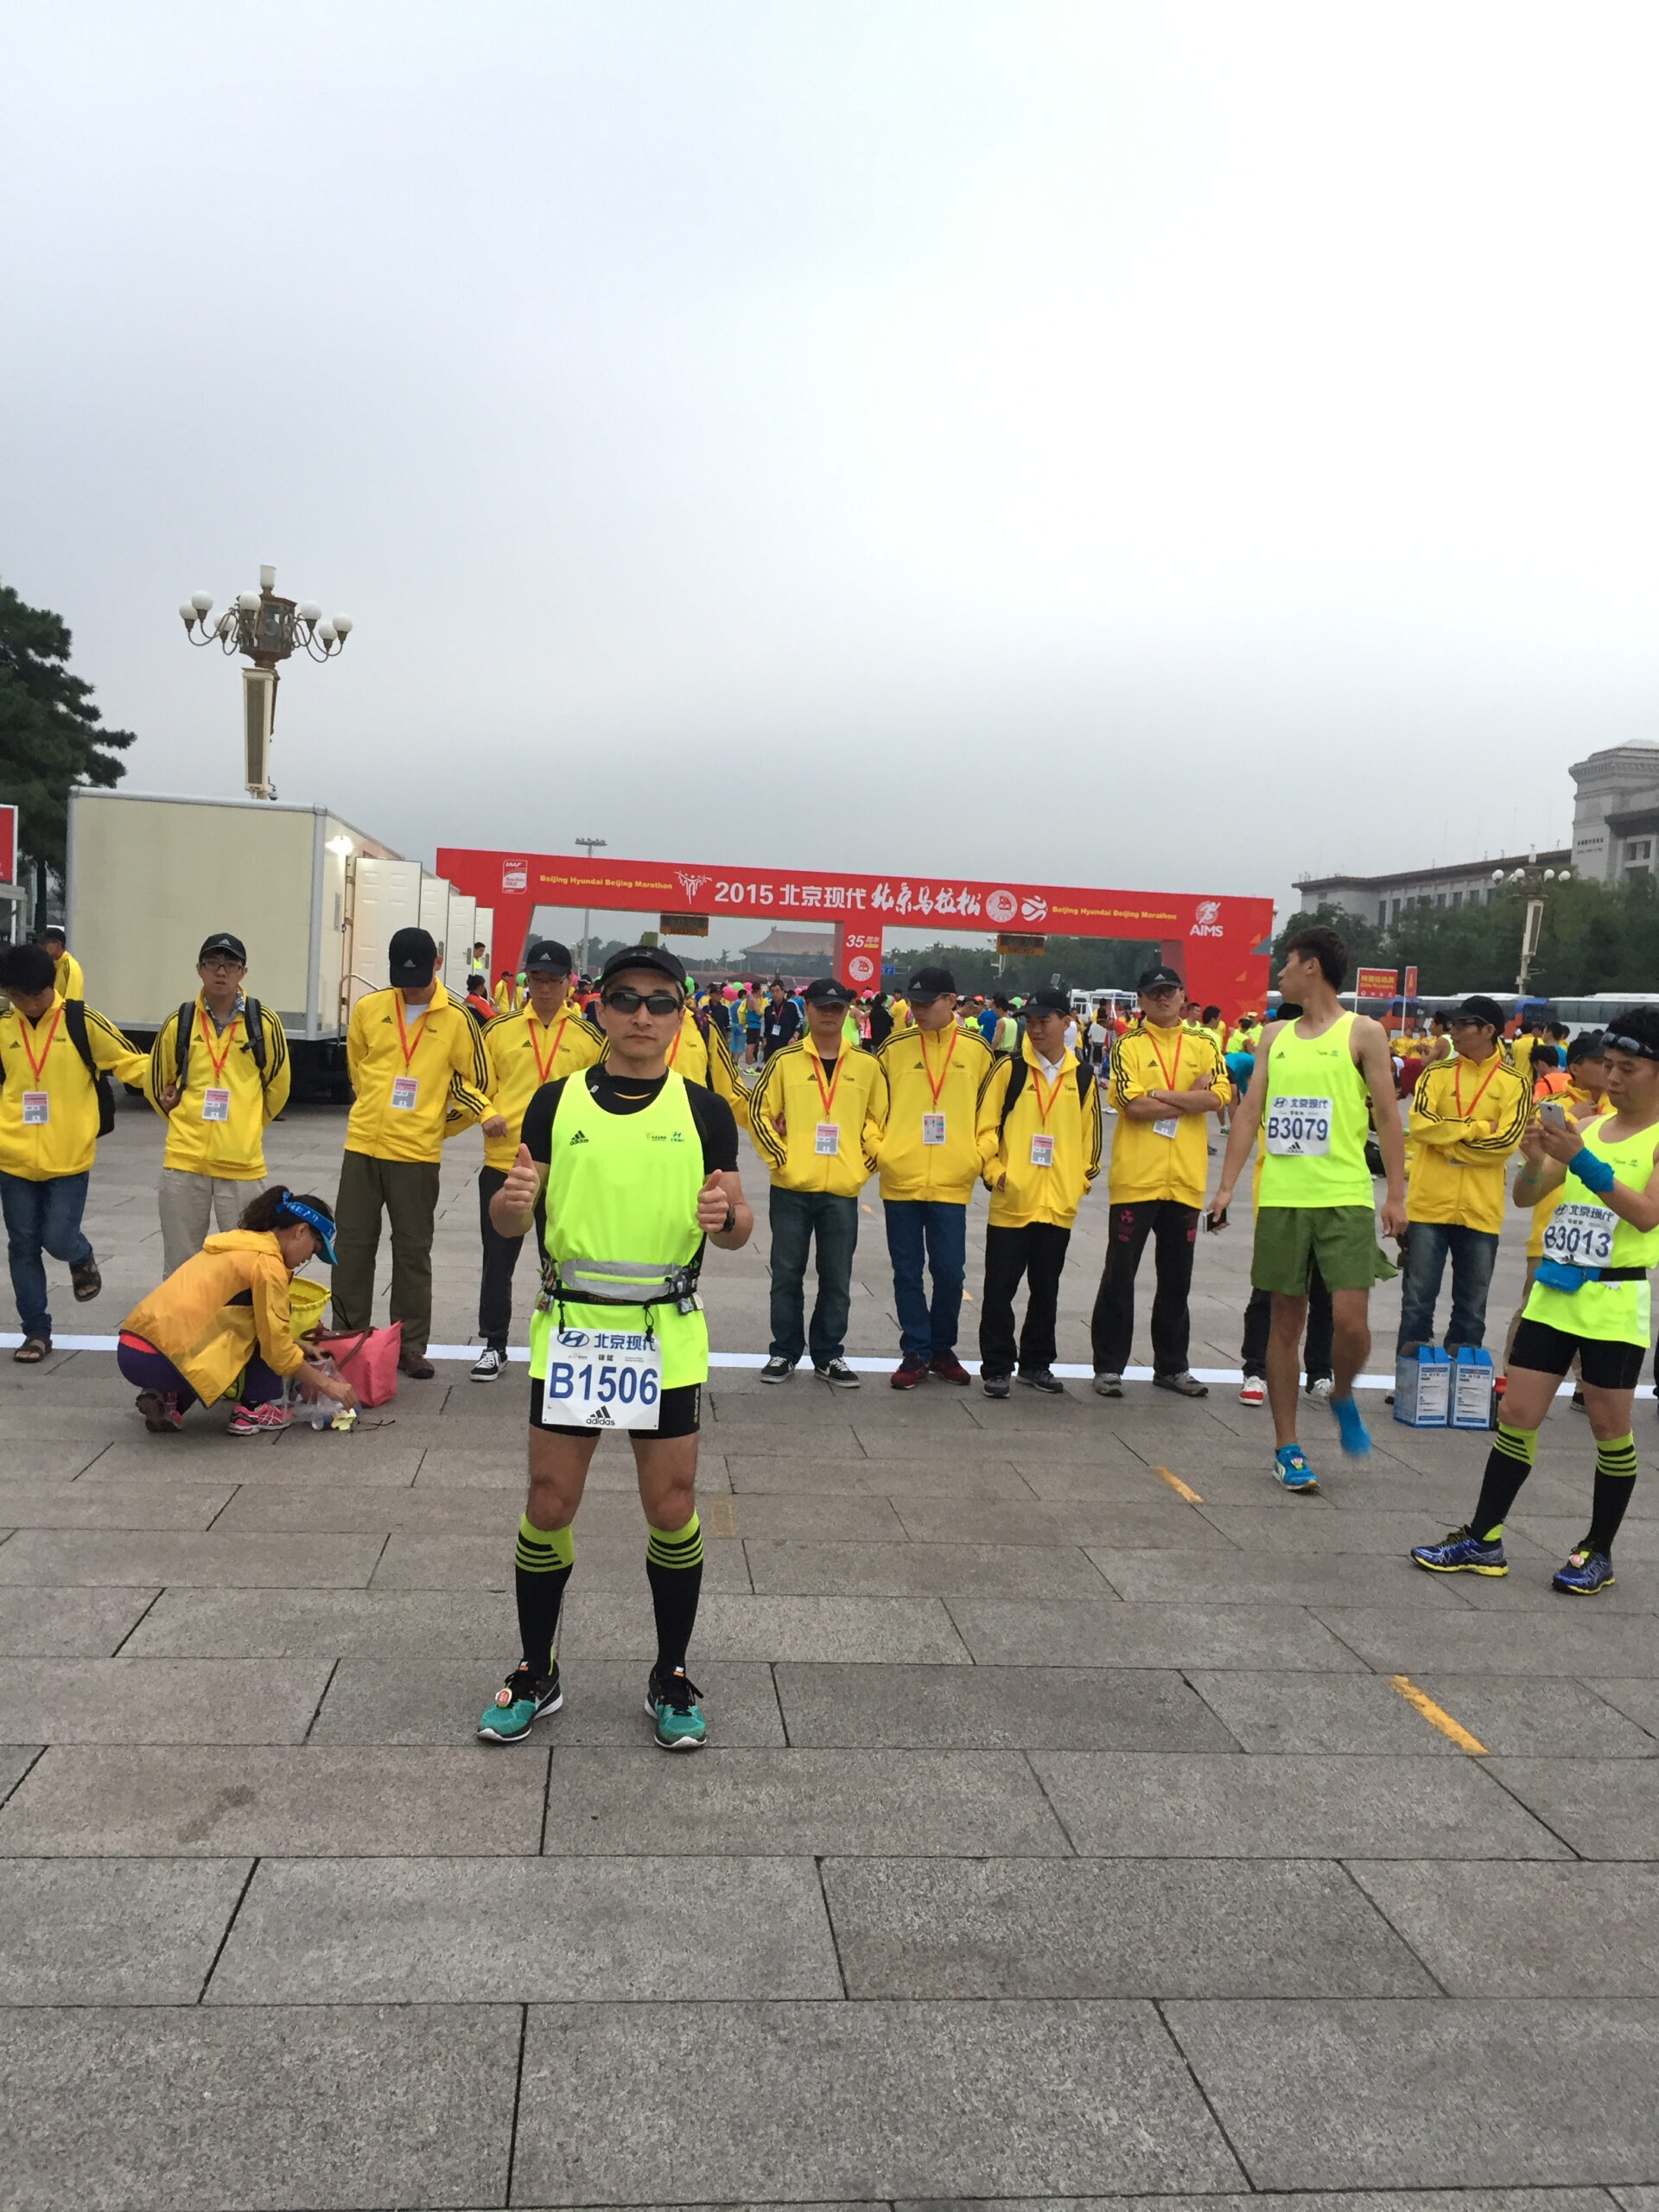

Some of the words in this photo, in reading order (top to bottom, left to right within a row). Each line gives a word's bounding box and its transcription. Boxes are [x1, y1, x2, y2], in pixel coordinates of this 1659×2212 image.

[540, 874, 568, 885] Beijing
[570, 876, 603, 886] Hyundai
[605, 878, 632, 888] Beijing
[635, 880, 673, 890] Marathon
[714, 881, 774, 906] 2015
[779, 883, 867, 910] 北京现代
[870, 882, 982, 916] 北京马拉松
[1052, 906, 1079, 916] Beijing
[1080, 907, 1112, 917] Hyundai
[1113, 909, 1140, 918] Beijing
[1141, 911, 1177, 920] Marathon
[1189, 924, 1224, 938] AIMS
[1290, 1098, 1328, 1109] 北京现代
[1268, 1117, 1328, 1141] B3079
[1569, 1205, 1614, 1222] 北京现代
[1544, 1225, 1611, 1258] B3013
[594, 1332, 656, 1351] 北京现代
[550, 1362, 658, 1405] B1506
[586, 1417, 615, 1426] adidas
